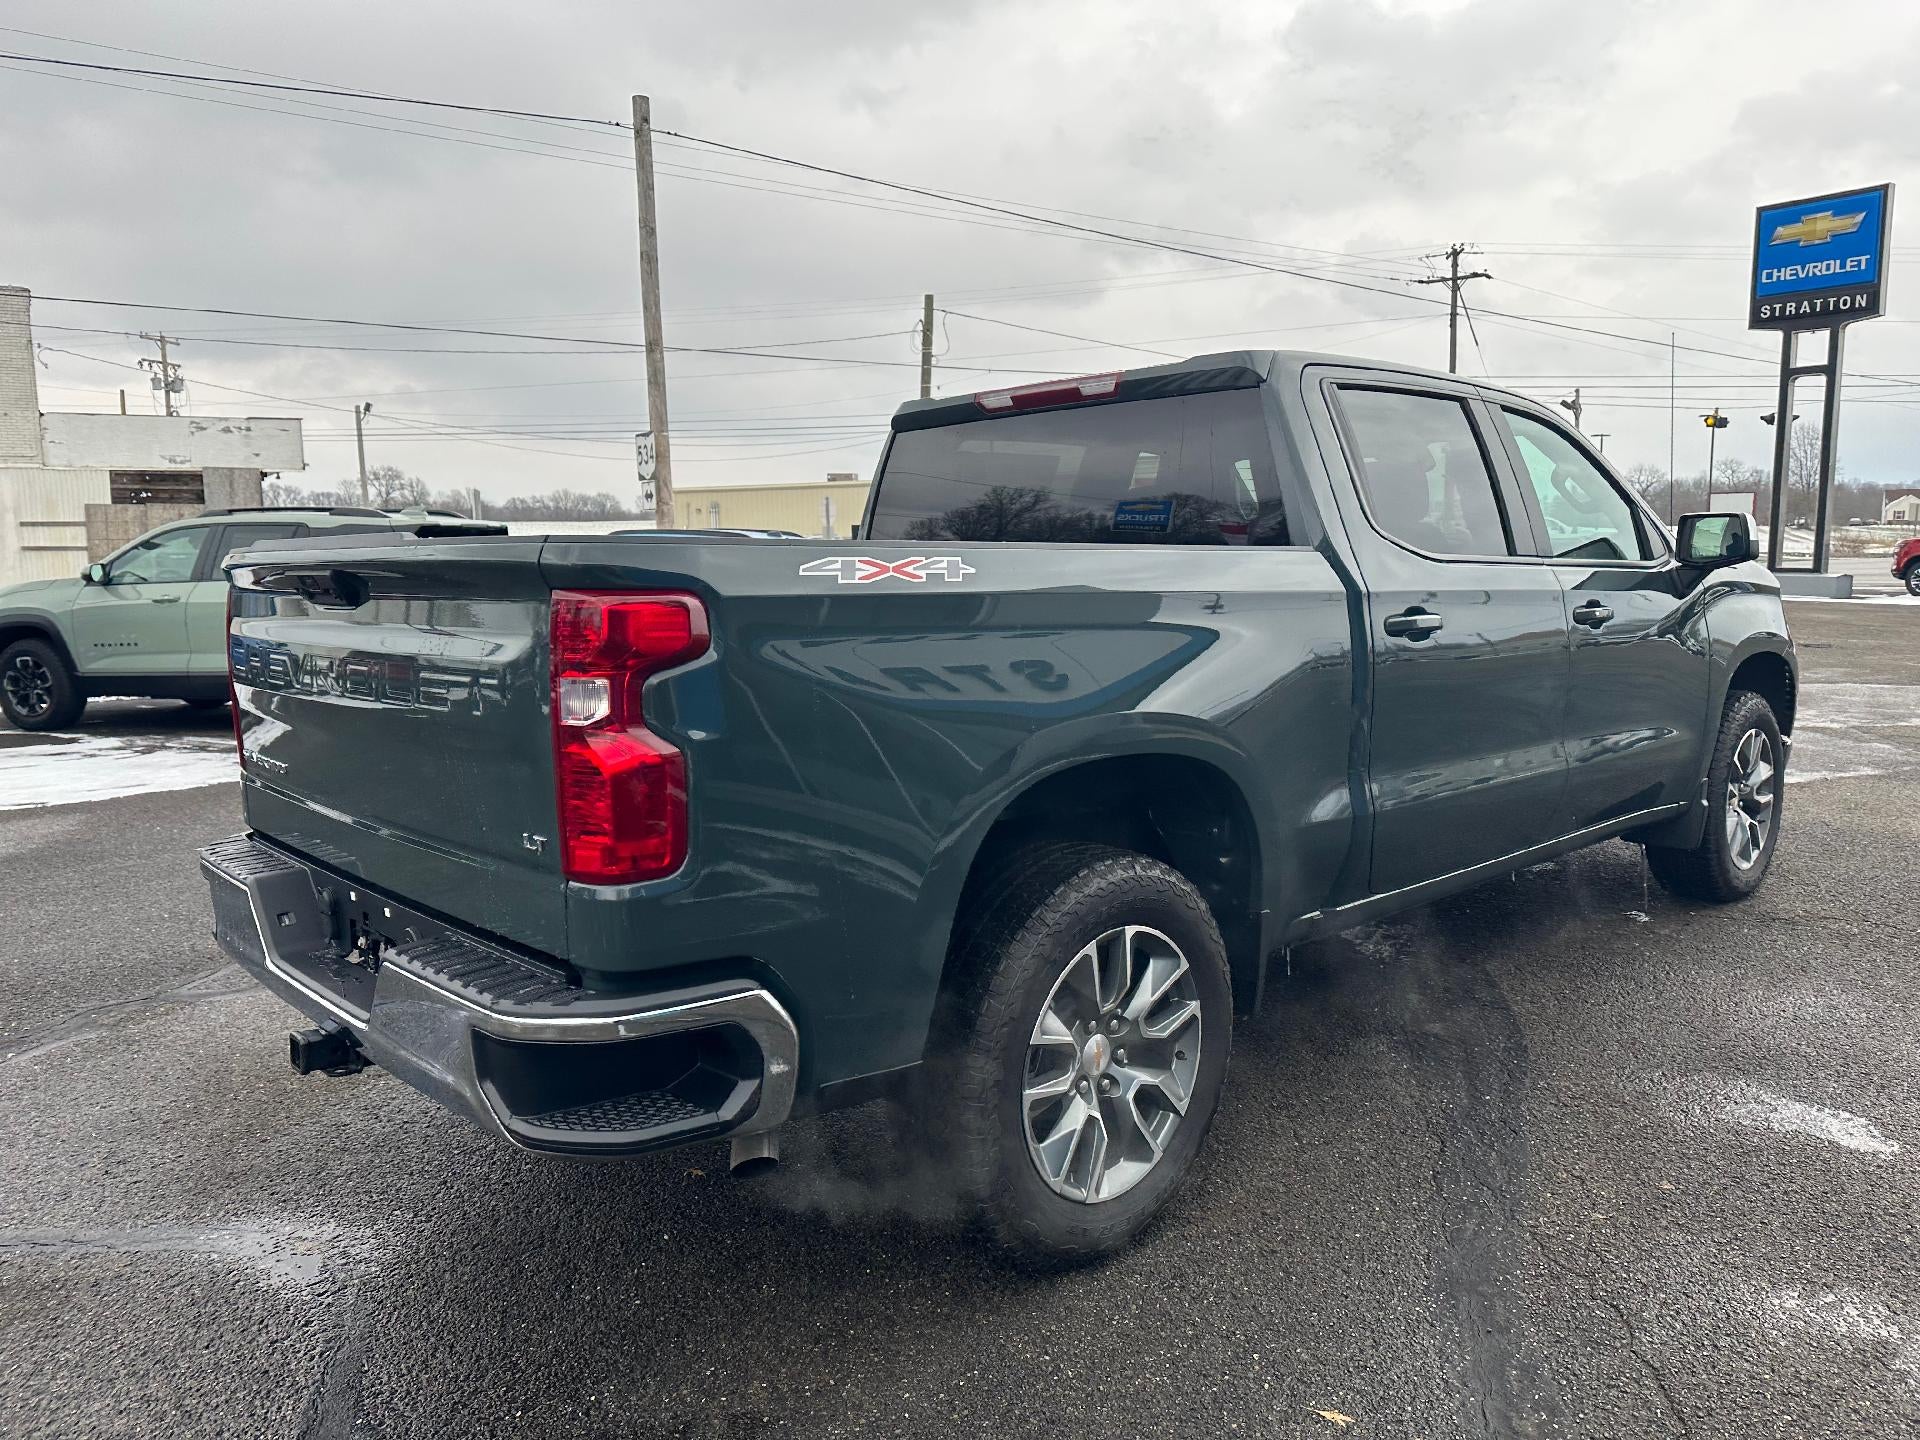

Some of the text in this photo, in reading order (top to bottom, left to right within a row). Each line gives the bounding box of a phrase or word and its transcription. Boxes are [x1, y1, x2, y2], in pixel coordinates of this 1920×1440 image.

[1761, 255, 1871, 283] CHEVROLET
[1760, 293, 1868, 319] STRATTON
[637, 442, 655, 466] 534
[799, 556, 977, 584] 4X4
[522, 832, 549, 856] LT
